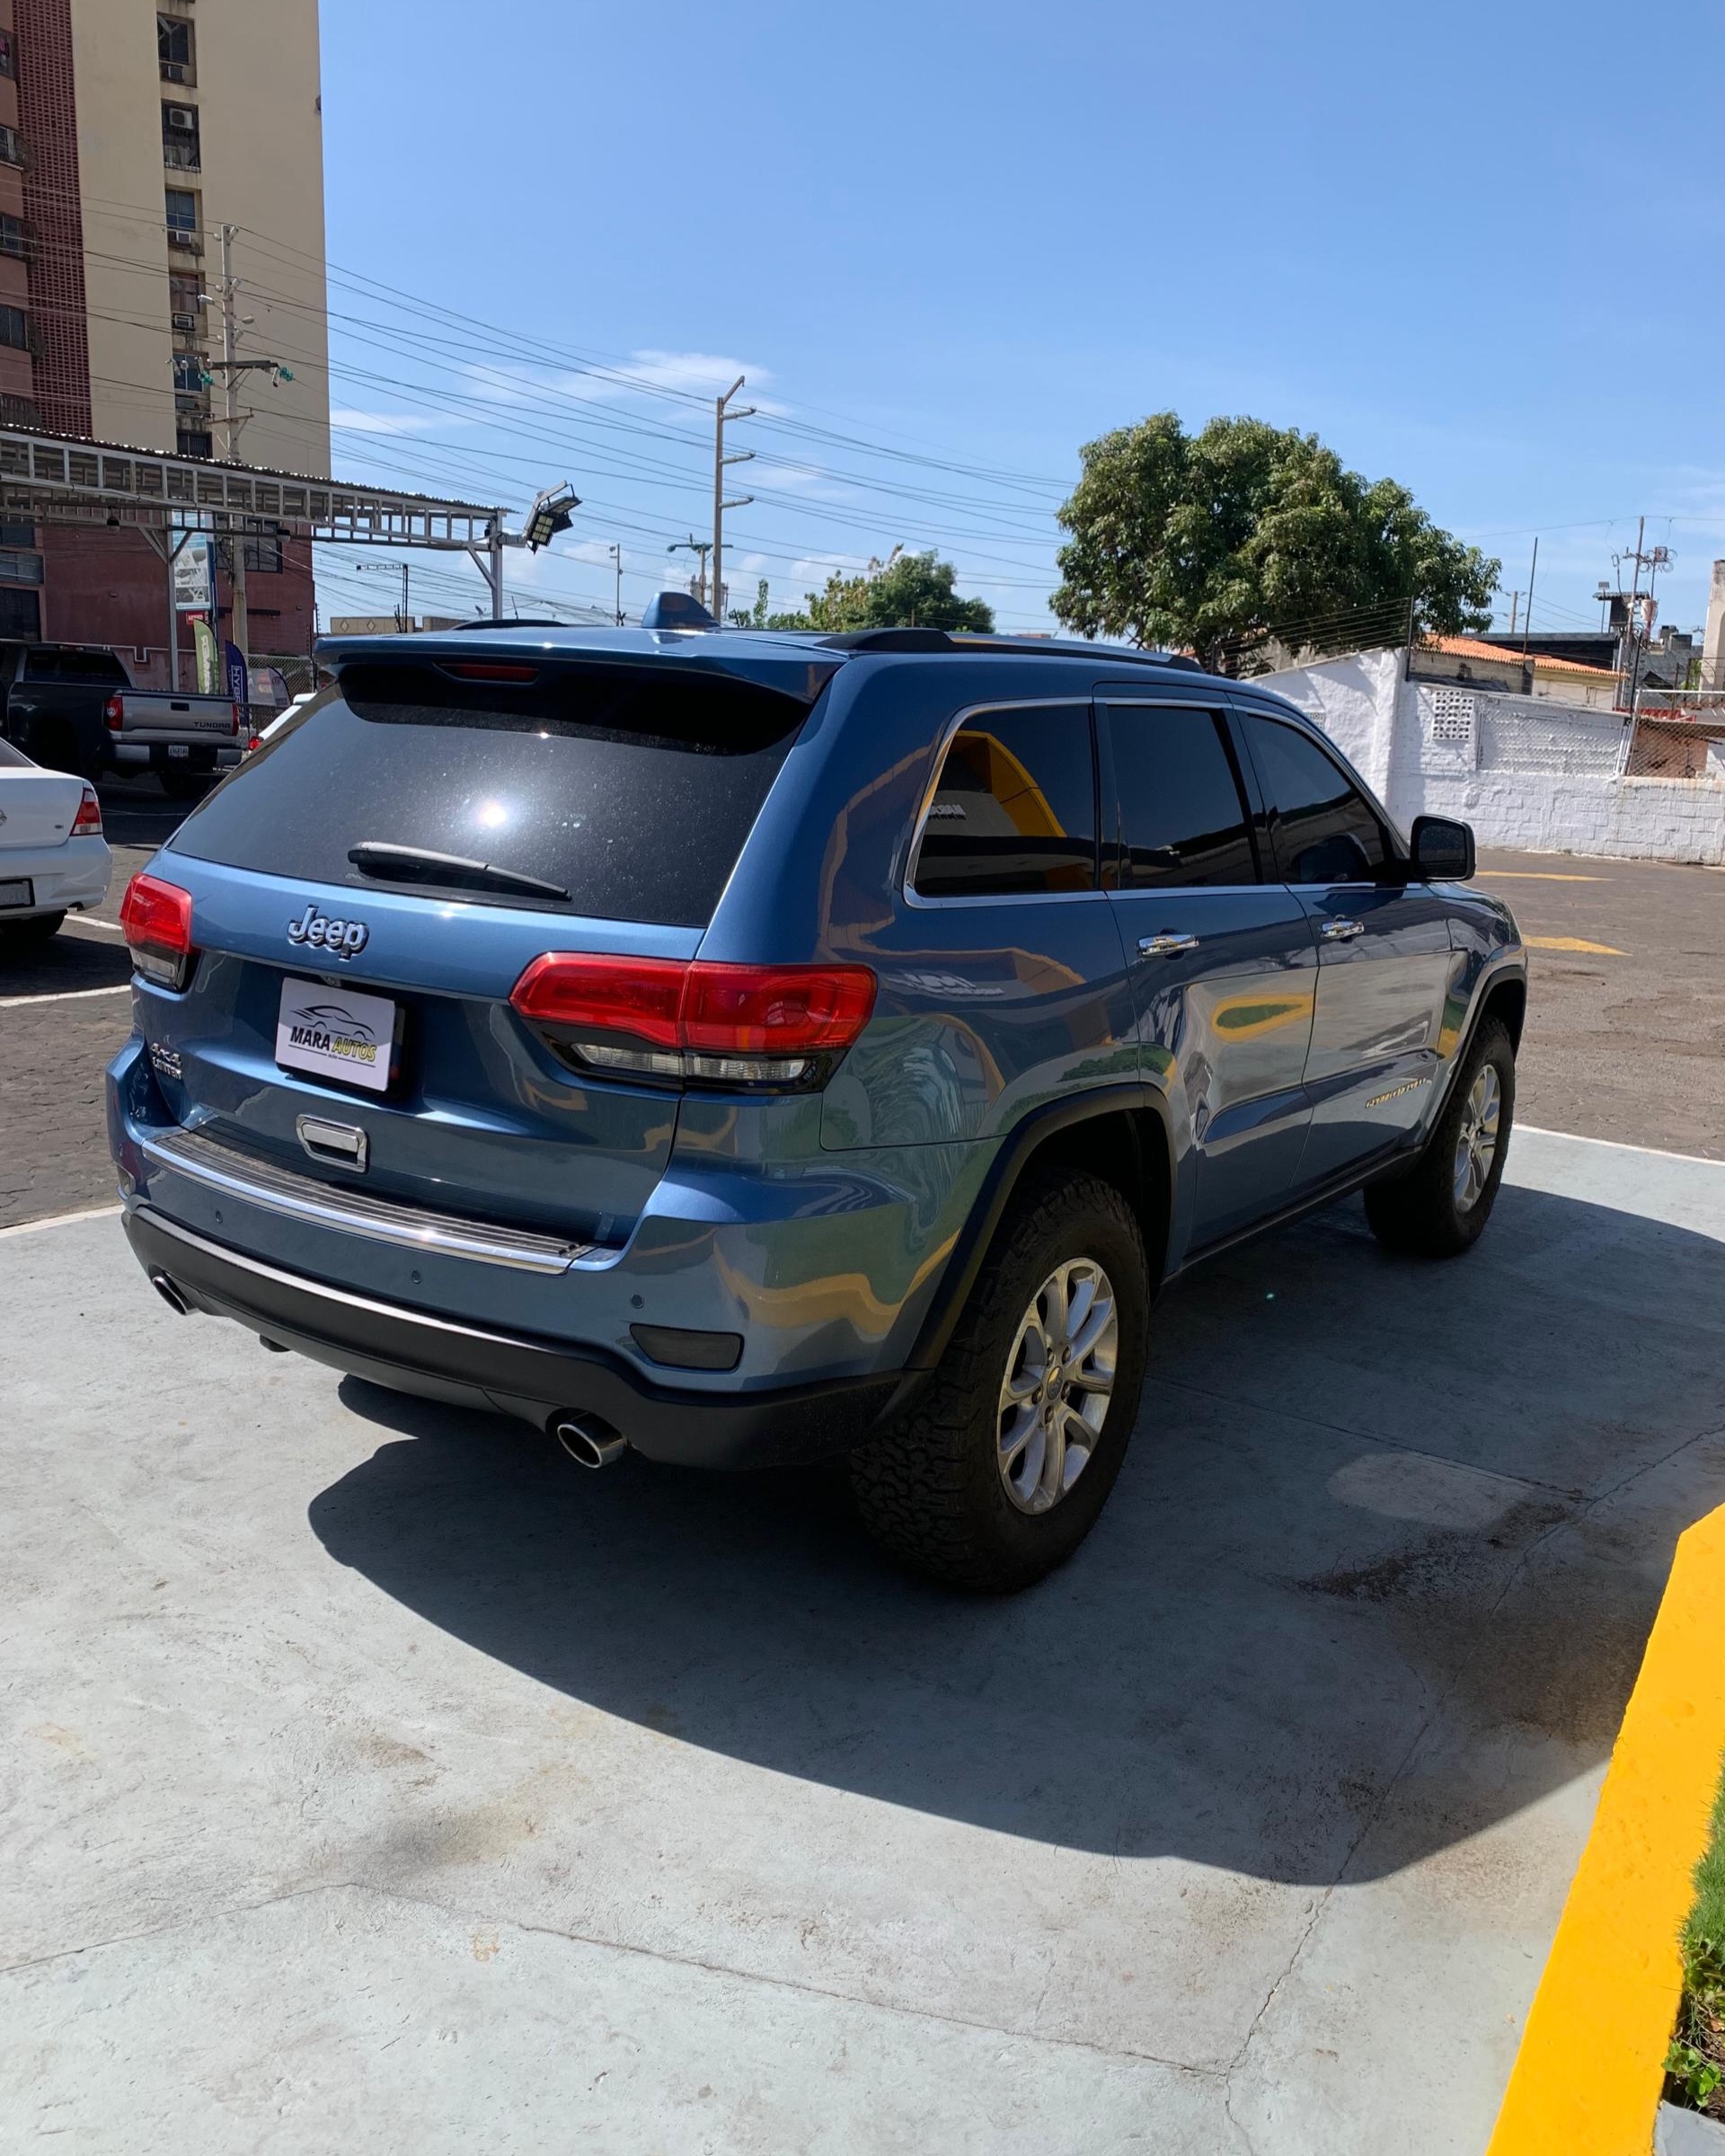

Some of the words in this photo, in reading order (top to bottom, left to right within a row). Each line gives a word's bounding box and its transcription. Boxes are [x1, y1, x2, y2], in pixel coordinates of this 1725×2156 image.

[288, 904, 369, 962] Jeep
[289, 1026, 331, 1051] MARA
[331, 1036, 377, 1062] AUTOS
